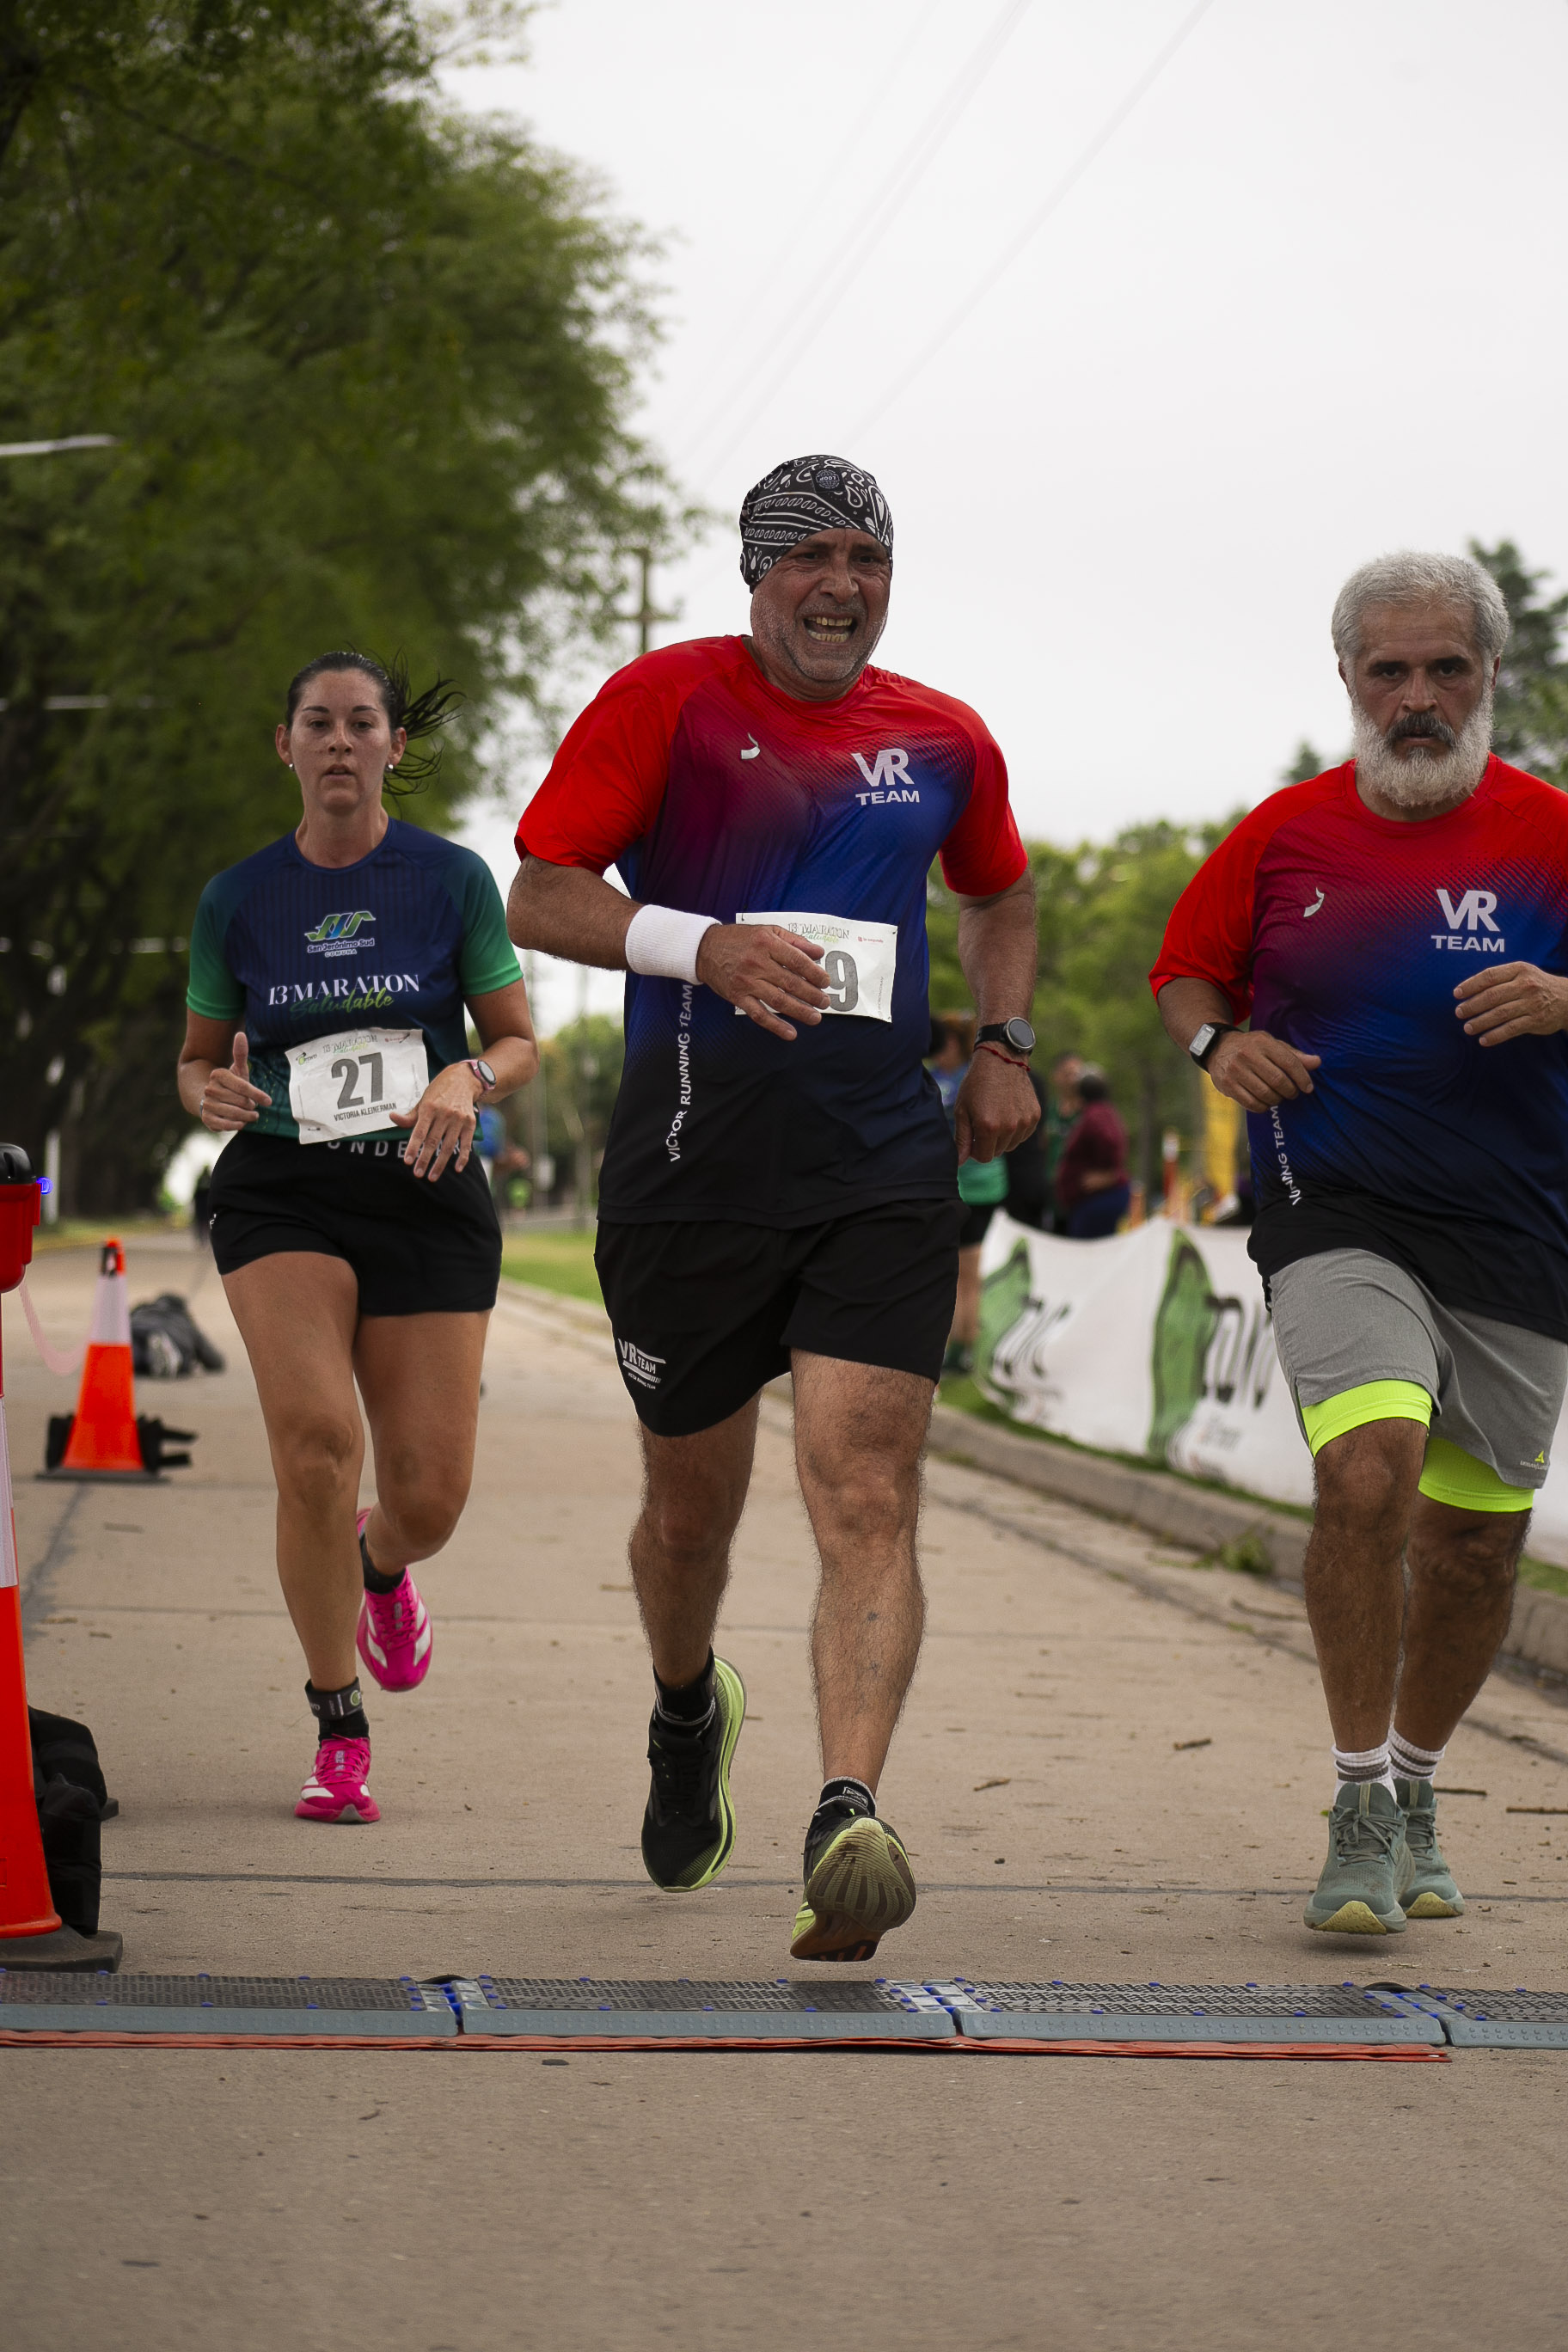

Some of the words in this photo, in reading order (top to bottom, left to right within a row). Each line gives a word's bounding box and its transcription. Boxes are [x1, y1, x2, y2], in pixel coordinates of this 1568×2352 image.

[851, 748, 916, 787] VR
[855, 789, 921, 806] TEAM
[1436, 888, 1501, 932] VR
[308, 945, 323, 953] San
[322, 940, 358, 952] Jerónimo
[359, 937, 375, 947] Sud
[324, 948, 358, 959] COMUNA
[1430, 934, 1505, 952] TEAM
[293, 973, 420, 1002] MARATON
[813, 949, 859, 1013] 9
[289, 986, 395, 1020] Saludable
[679, 984, 693, 1027] TEAM
[331, 1051, 384, 1110] 27
[677, 1032, 692, 1106] RUNNING
[334, 1109, 361, 1122] VICTORIA
[360, 1101, 397, 1117] KLEINERMAN
[1270, 1106, 1285, 1149] TEAM
[666, 1110, 688, 1162] VICTOR
[618, 1338, 637, 1364] VR
[637, 1356, 656, 1374] TEAM
